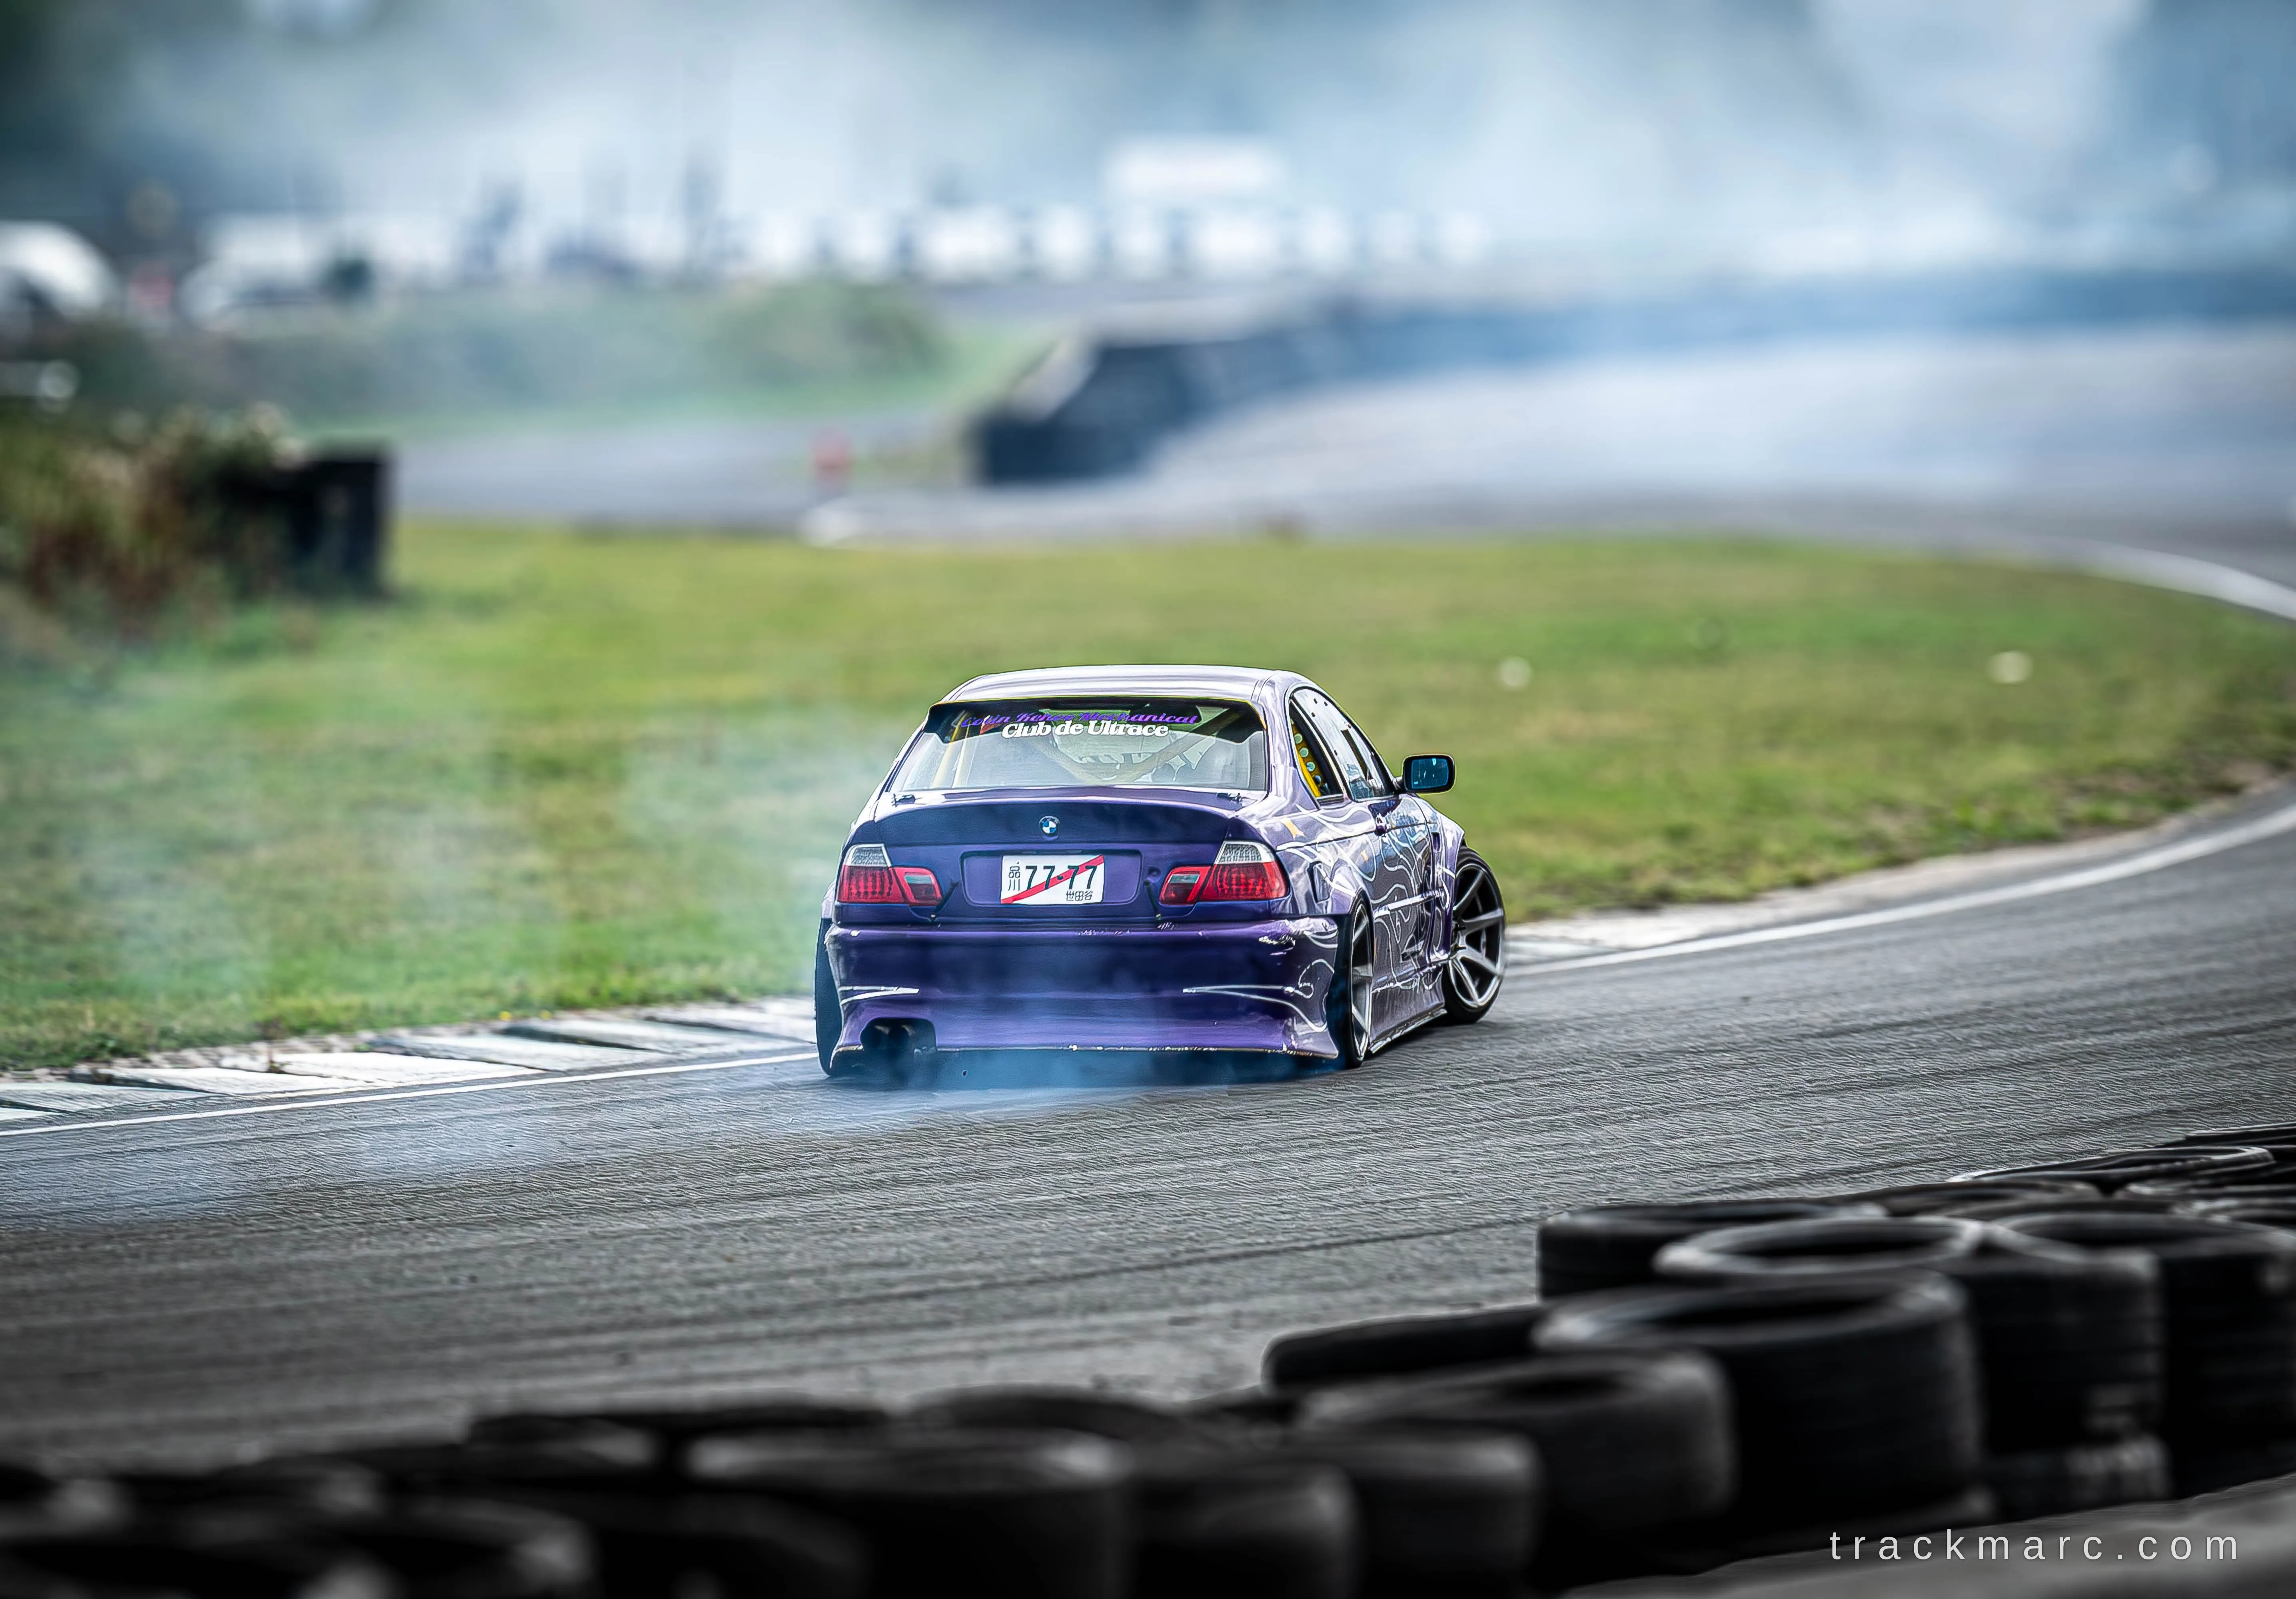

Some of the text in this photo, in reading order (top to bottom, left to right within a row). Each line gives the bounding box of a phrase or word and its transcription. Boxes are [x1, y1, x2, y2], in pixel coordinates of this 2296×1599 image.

[1078, 712, 1198, 724] Mechanical
[1001, 720, 1168, 738] Club de Ultrace
